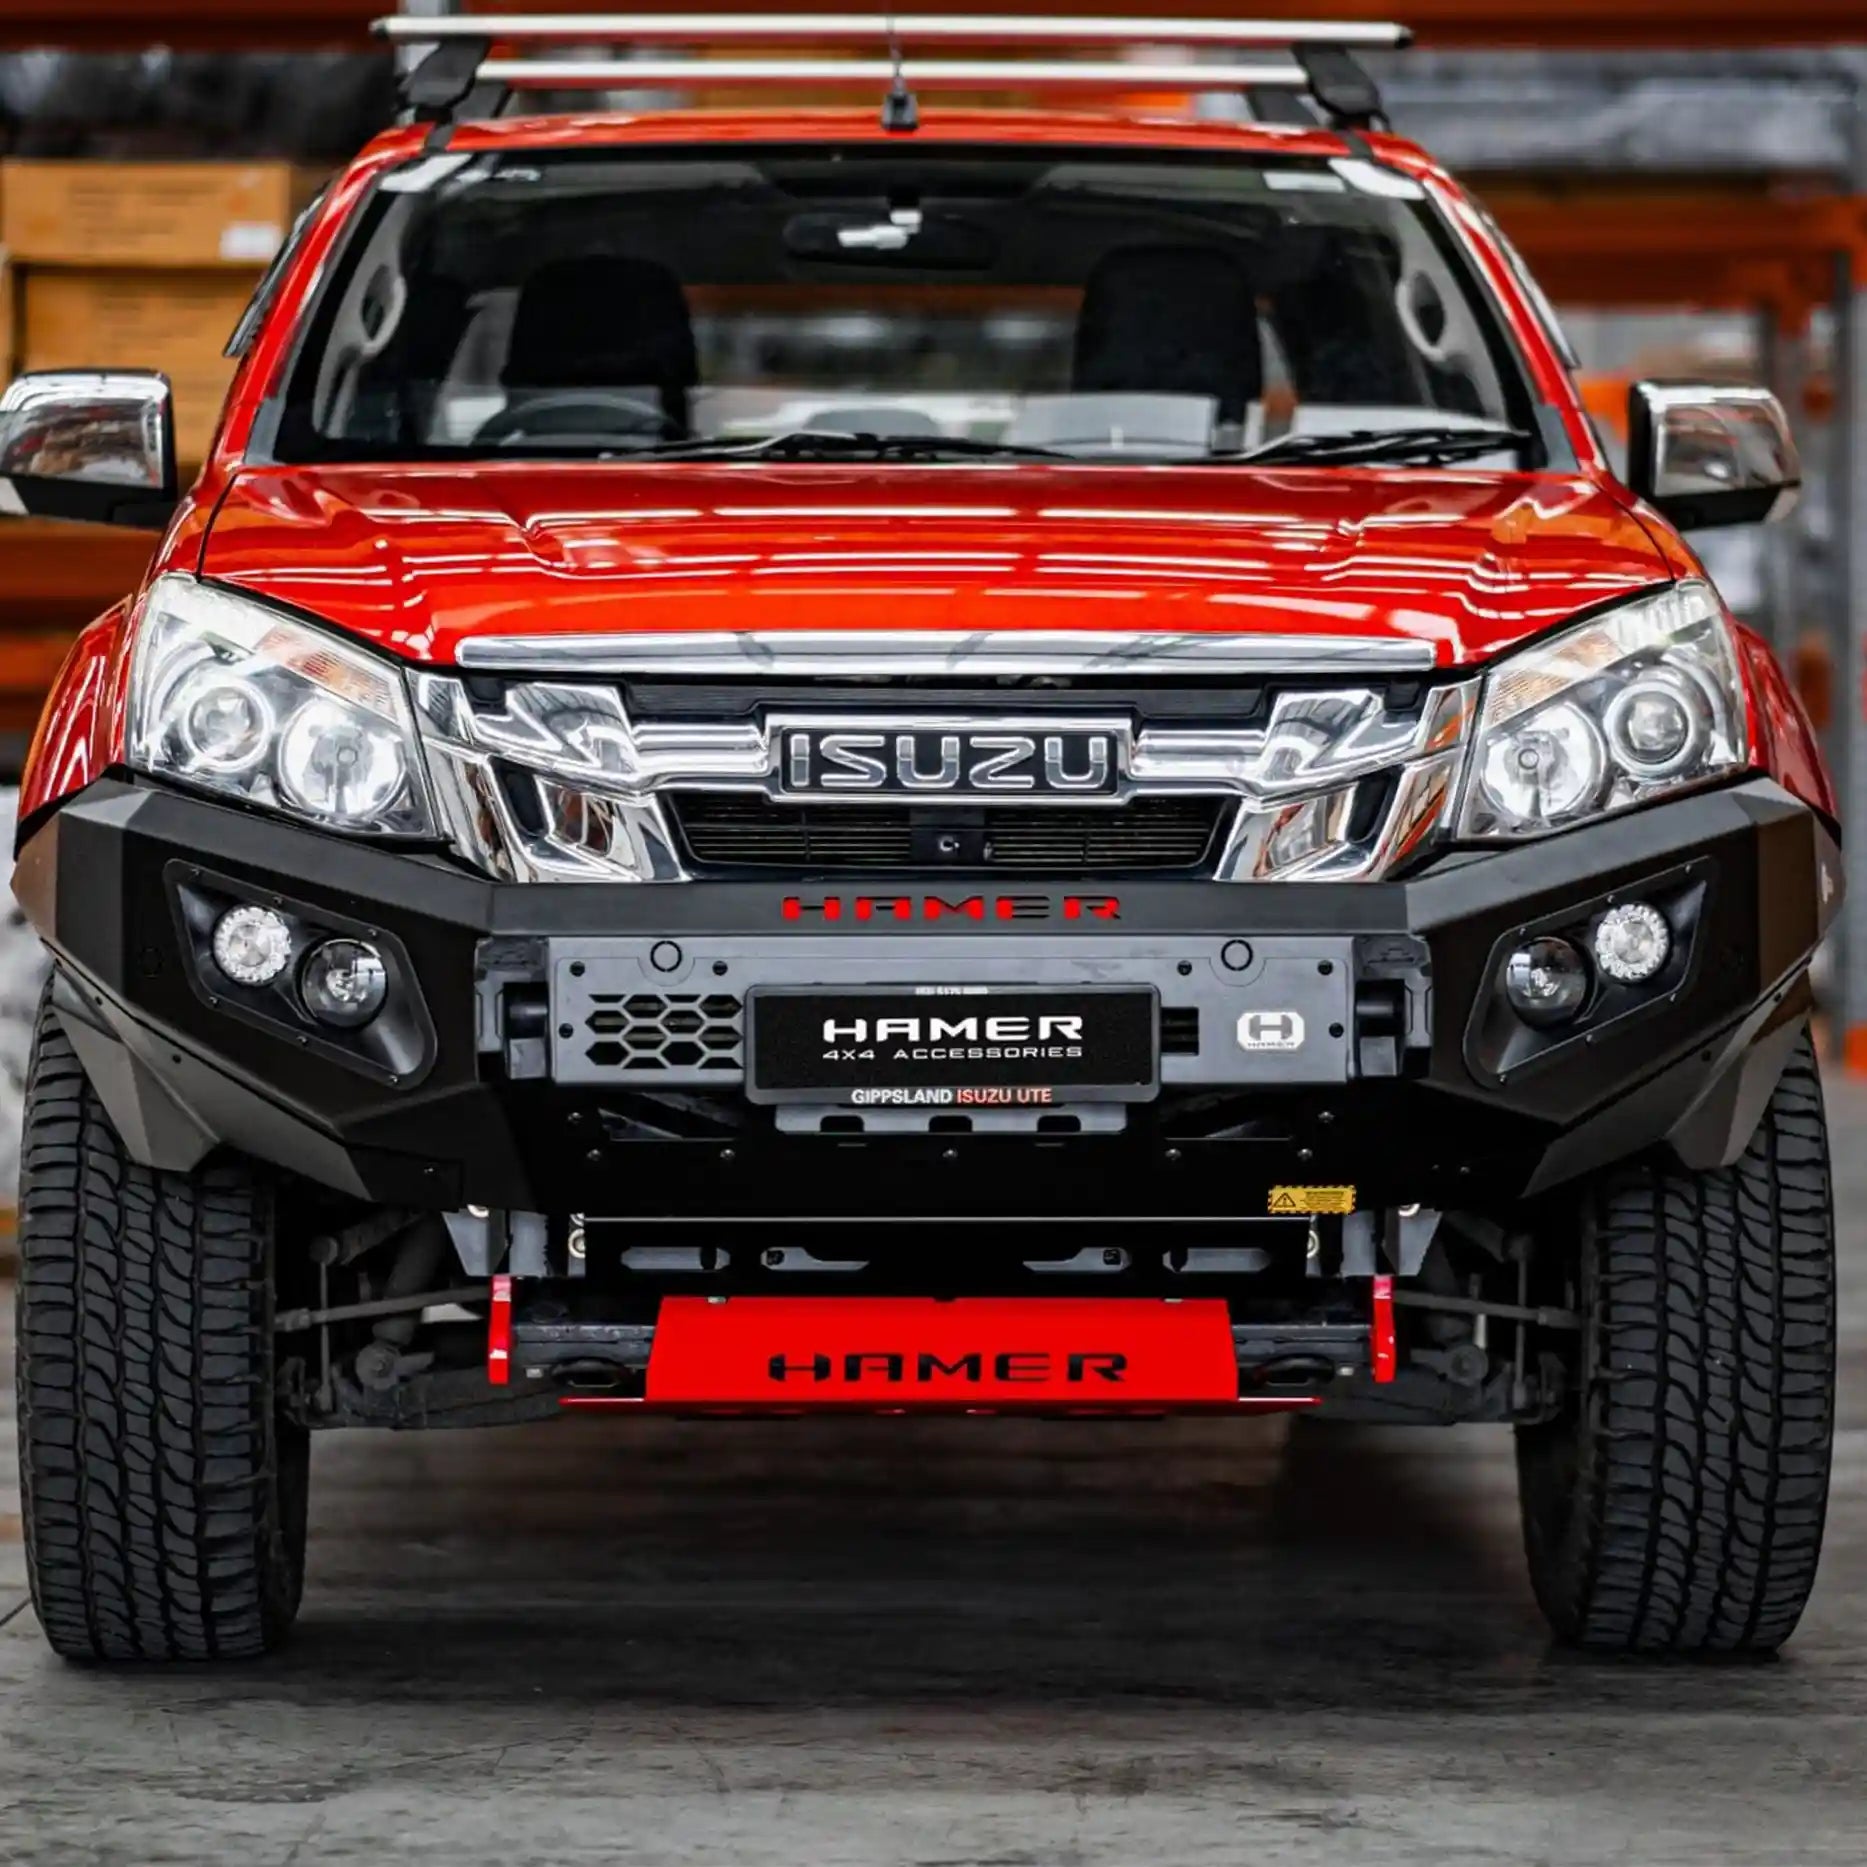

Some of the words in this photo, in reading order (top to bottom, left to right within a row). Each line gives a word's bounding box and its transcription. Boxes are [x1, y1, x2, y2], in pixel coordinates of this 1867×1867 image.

[788, 733, 1109, 789] ISUZU
[782, 896, 1121, 920] HAMER
[822, 1015, 1083, 1043] HAMER
[893, 1046, 1083, 1060] ACCESSORIES
[851, 1089, 953, 1105] GIPPSLAND
[956, 1089, 1013, 1105] ISUZU
[1016, 1088, 1053, 1104] UTE
[768, 1352, 1127, 1383] HAMER
